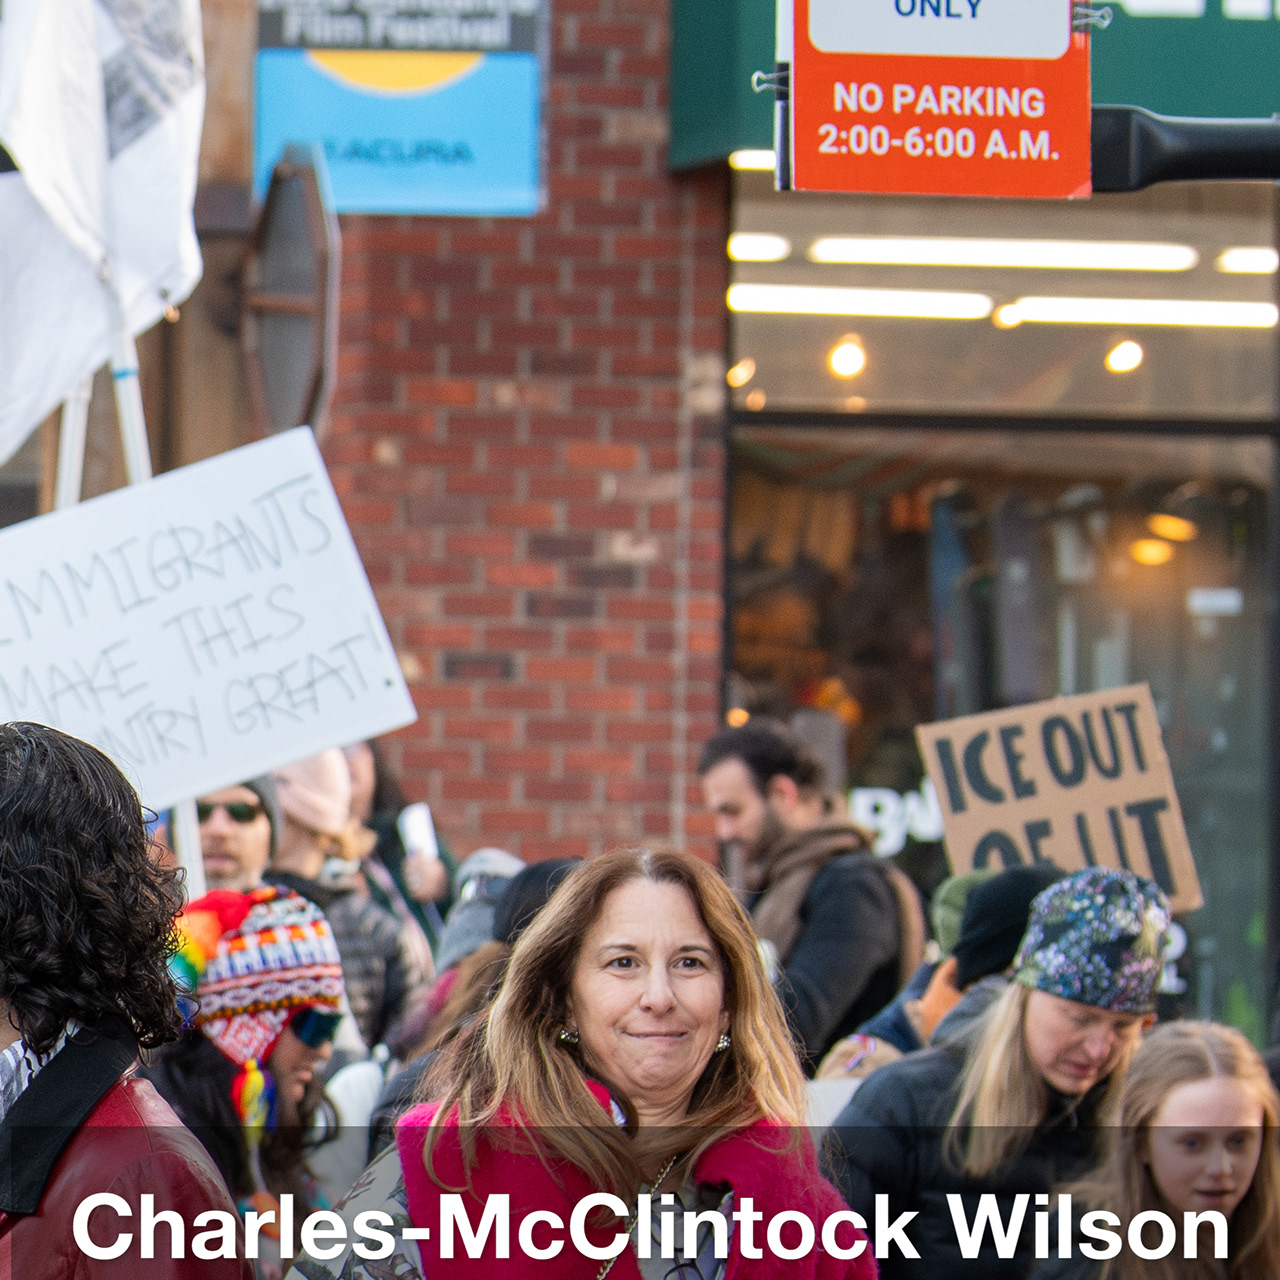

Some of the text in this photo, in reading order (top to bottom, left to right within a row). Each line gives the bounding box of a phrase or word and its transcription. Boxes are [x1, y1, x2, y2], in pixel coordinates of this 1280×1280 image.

[283, 10, 511, 47] Film Festival
[833, 81, 1046, 118] NO PARKING
[817, 122, 1060, 161] 2:00-6:00 A.M.
[161, 582, 306, 677] THIS
[223, 612, 396, 735] GREAT!
[935, 702, 1146, 817] ICE OUT
